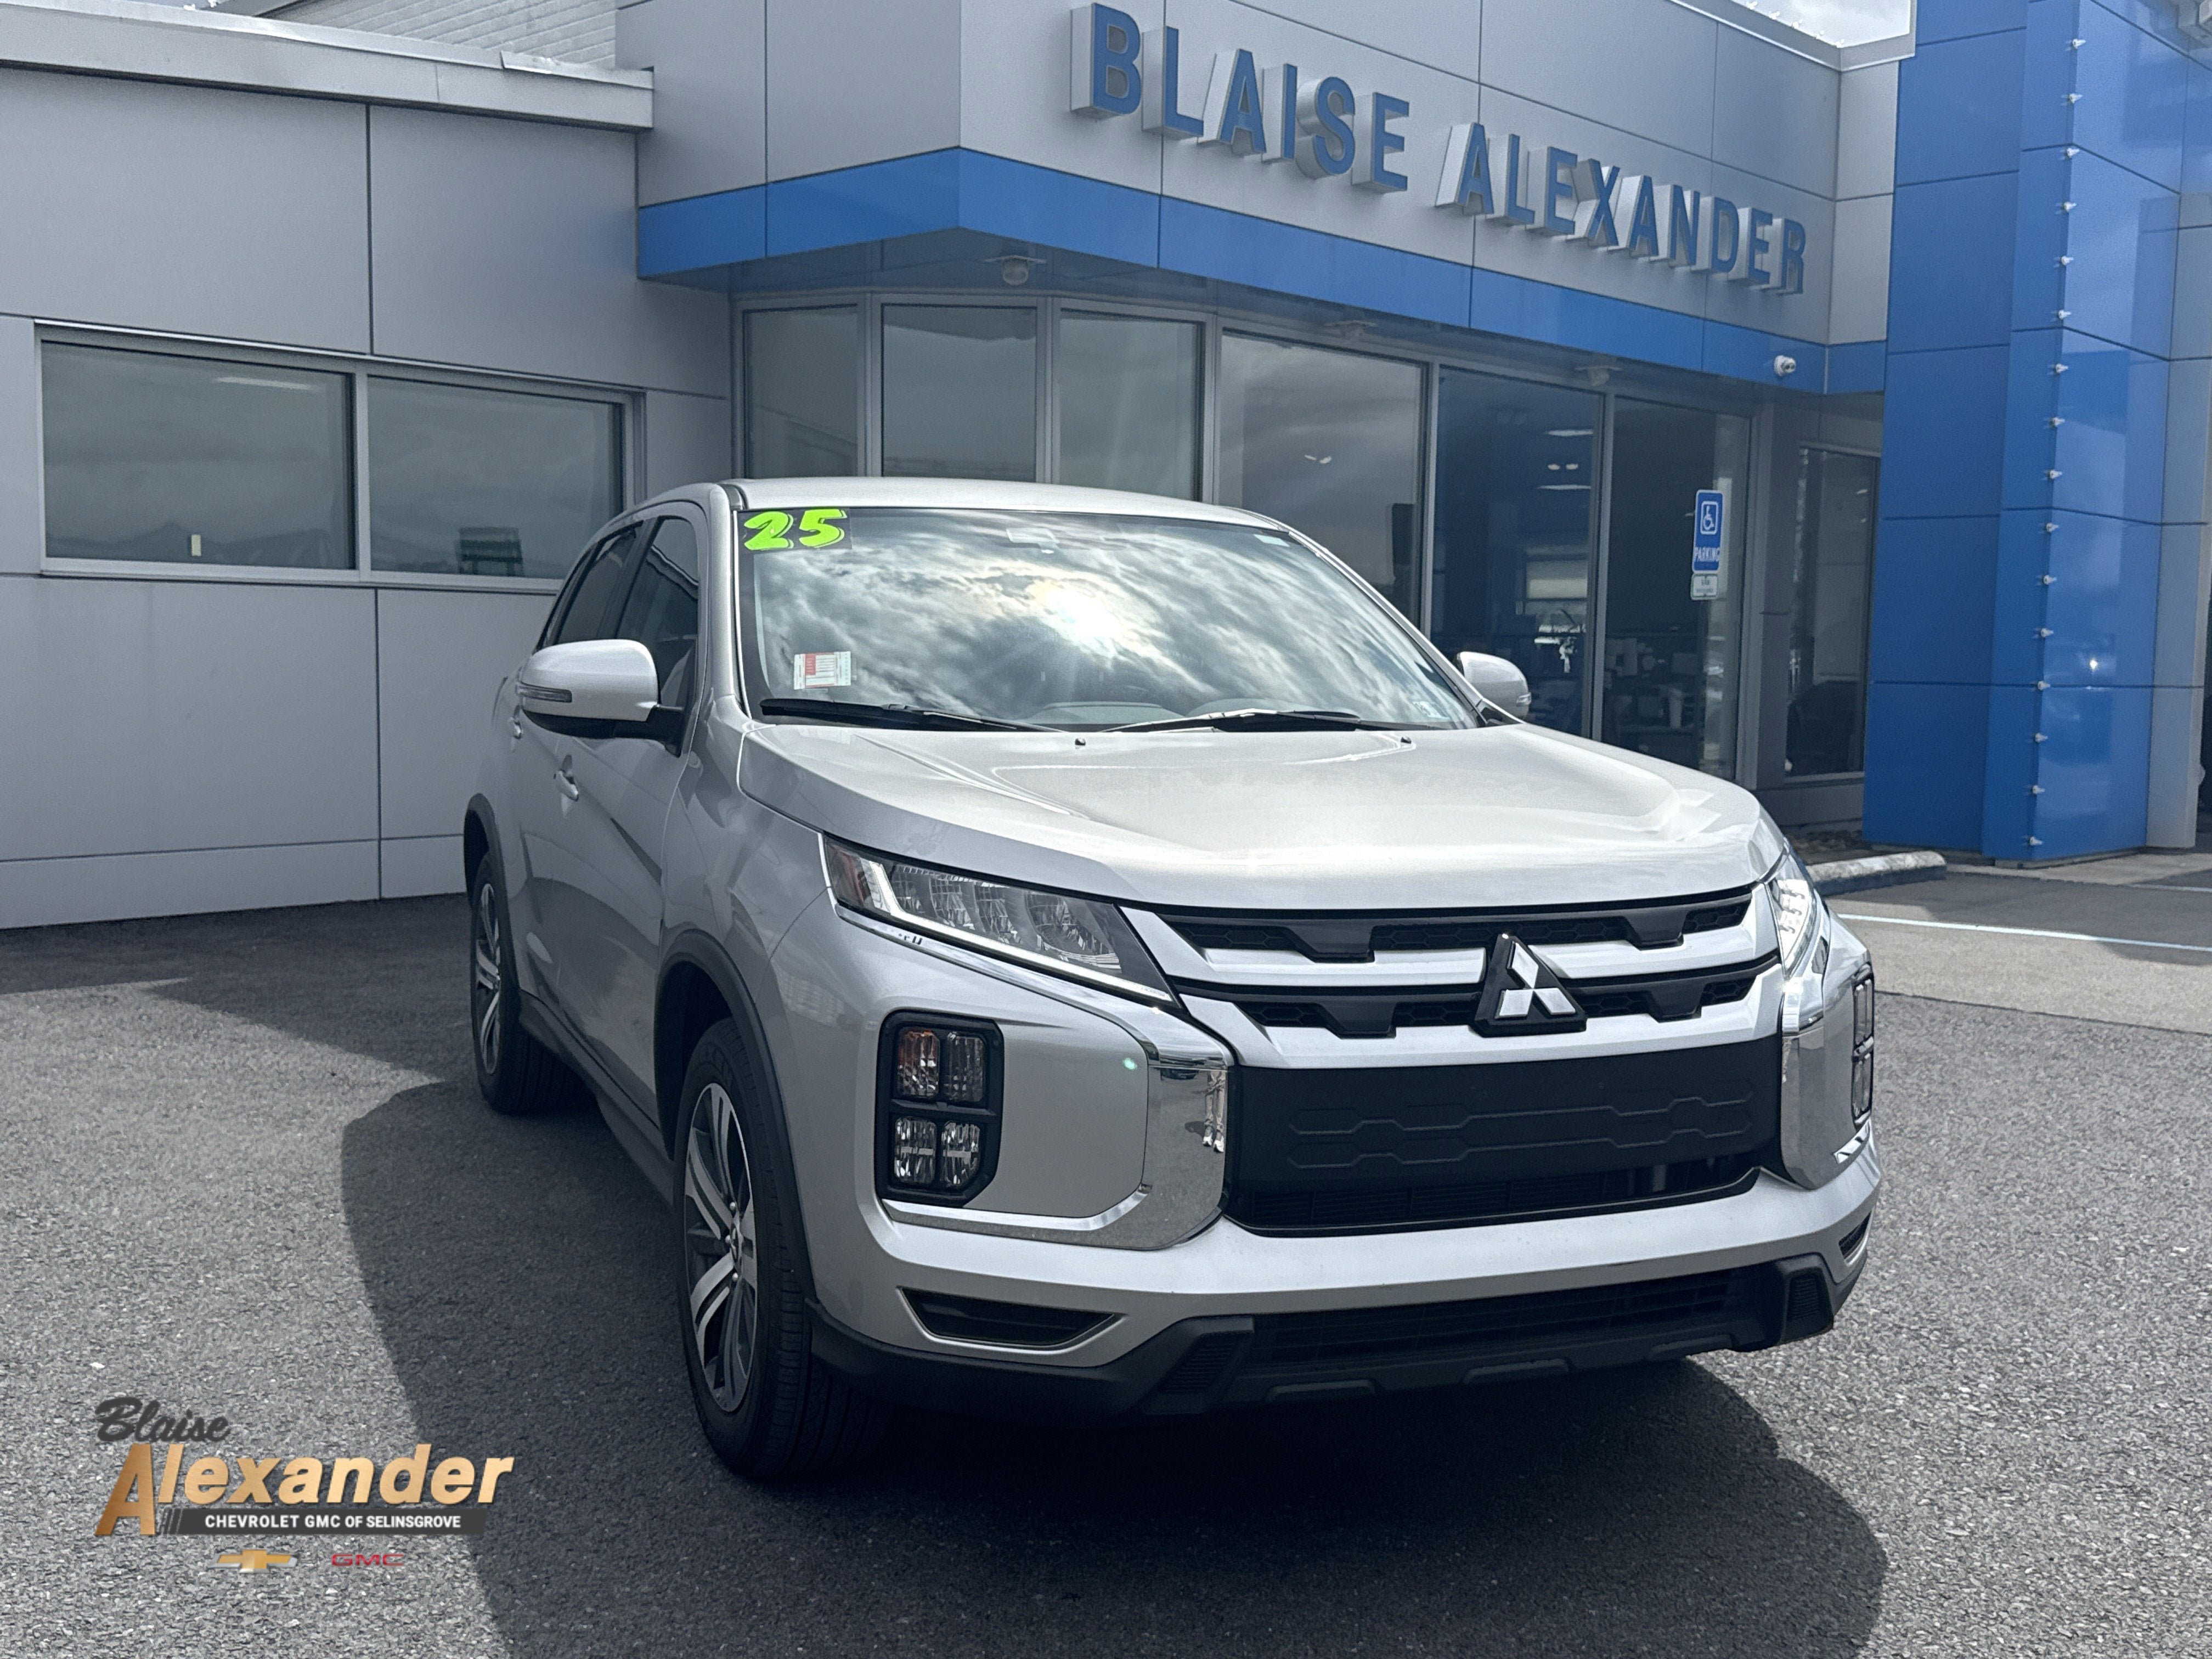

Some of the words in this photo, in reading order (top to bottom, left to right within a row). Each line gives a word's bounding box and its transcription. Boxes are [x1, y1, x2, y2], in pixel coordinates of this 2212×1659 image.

[1089, 2, 1410, 191] BLAISE
[1453, 122, 1807, 295] ALEXANDER
[744, 508, 848, 550] 25
